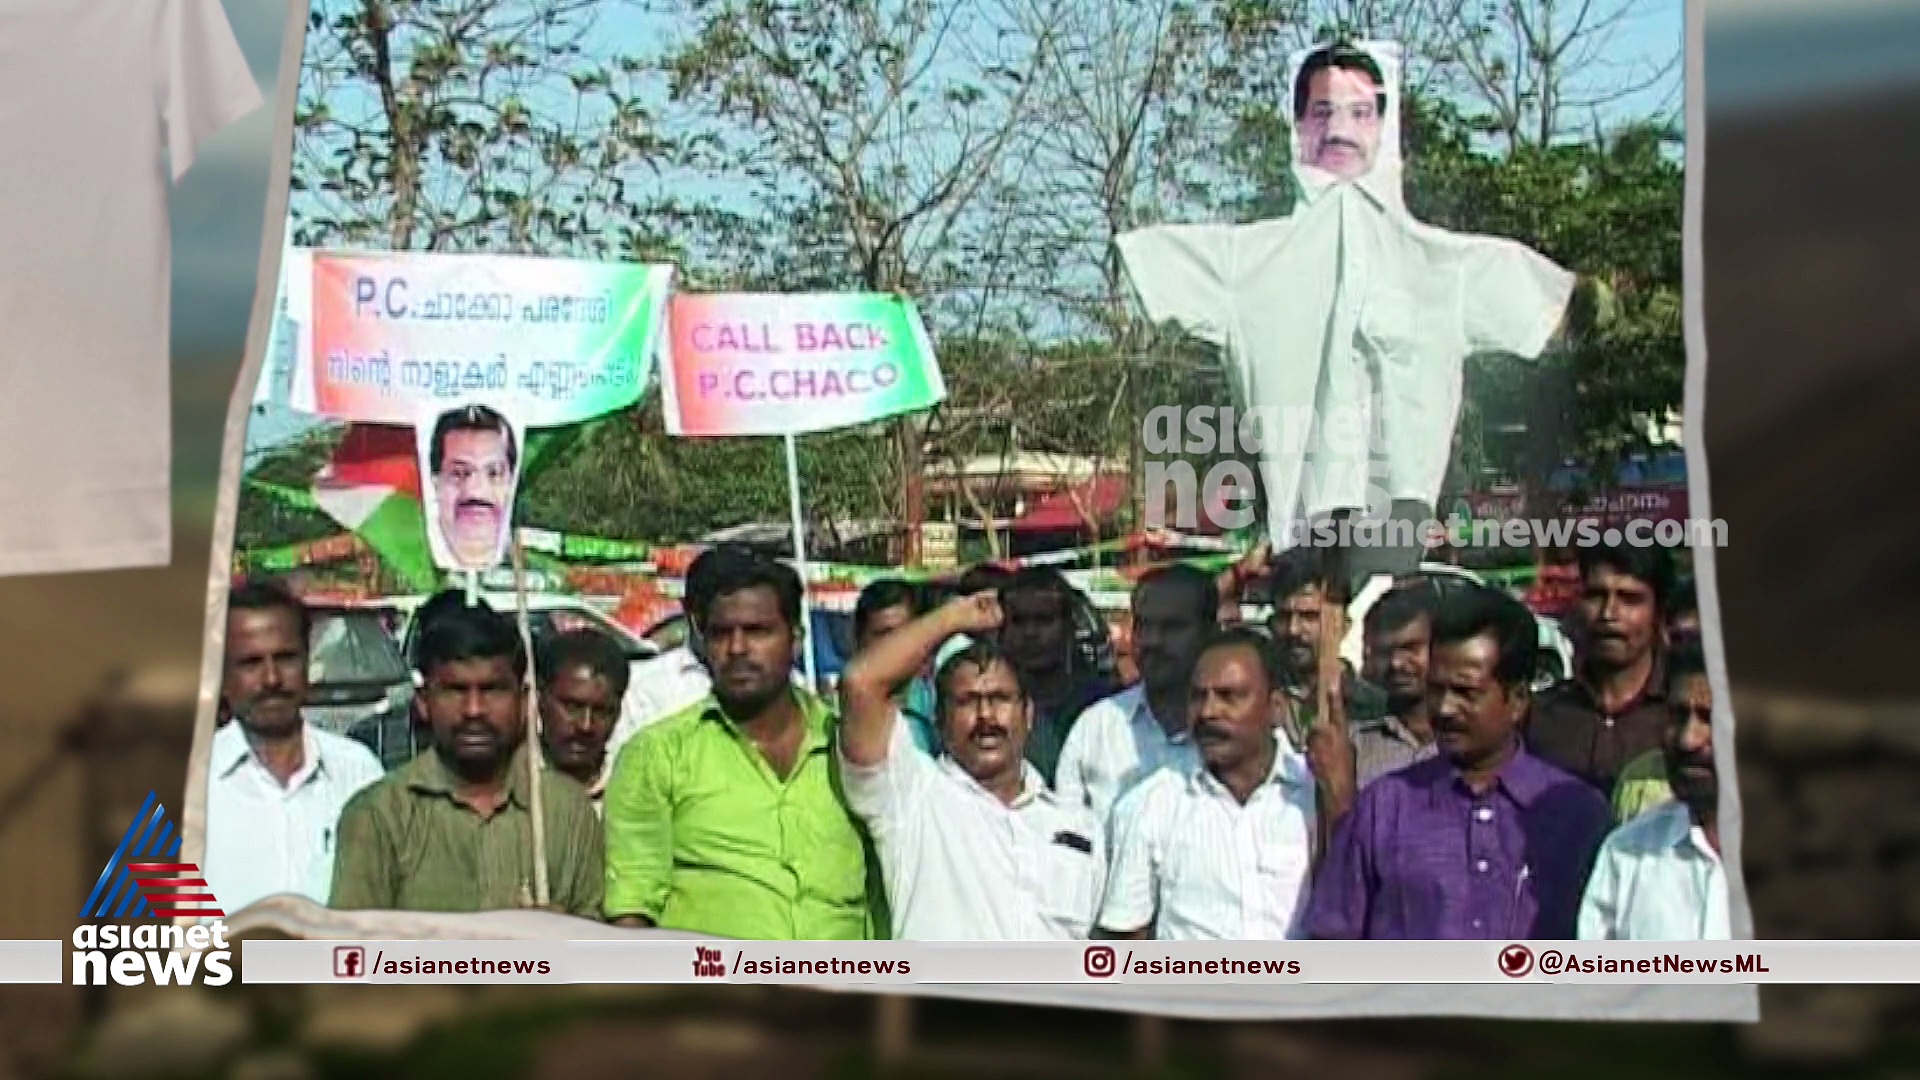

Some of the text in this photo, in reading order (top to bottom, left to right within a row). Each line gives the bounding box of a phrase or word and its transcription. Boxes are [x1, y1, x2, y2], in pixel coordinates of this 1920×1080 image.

[691, 322, 888, 352] CALL BACK
[699, 361, 897, 399] P.C.CHACO
